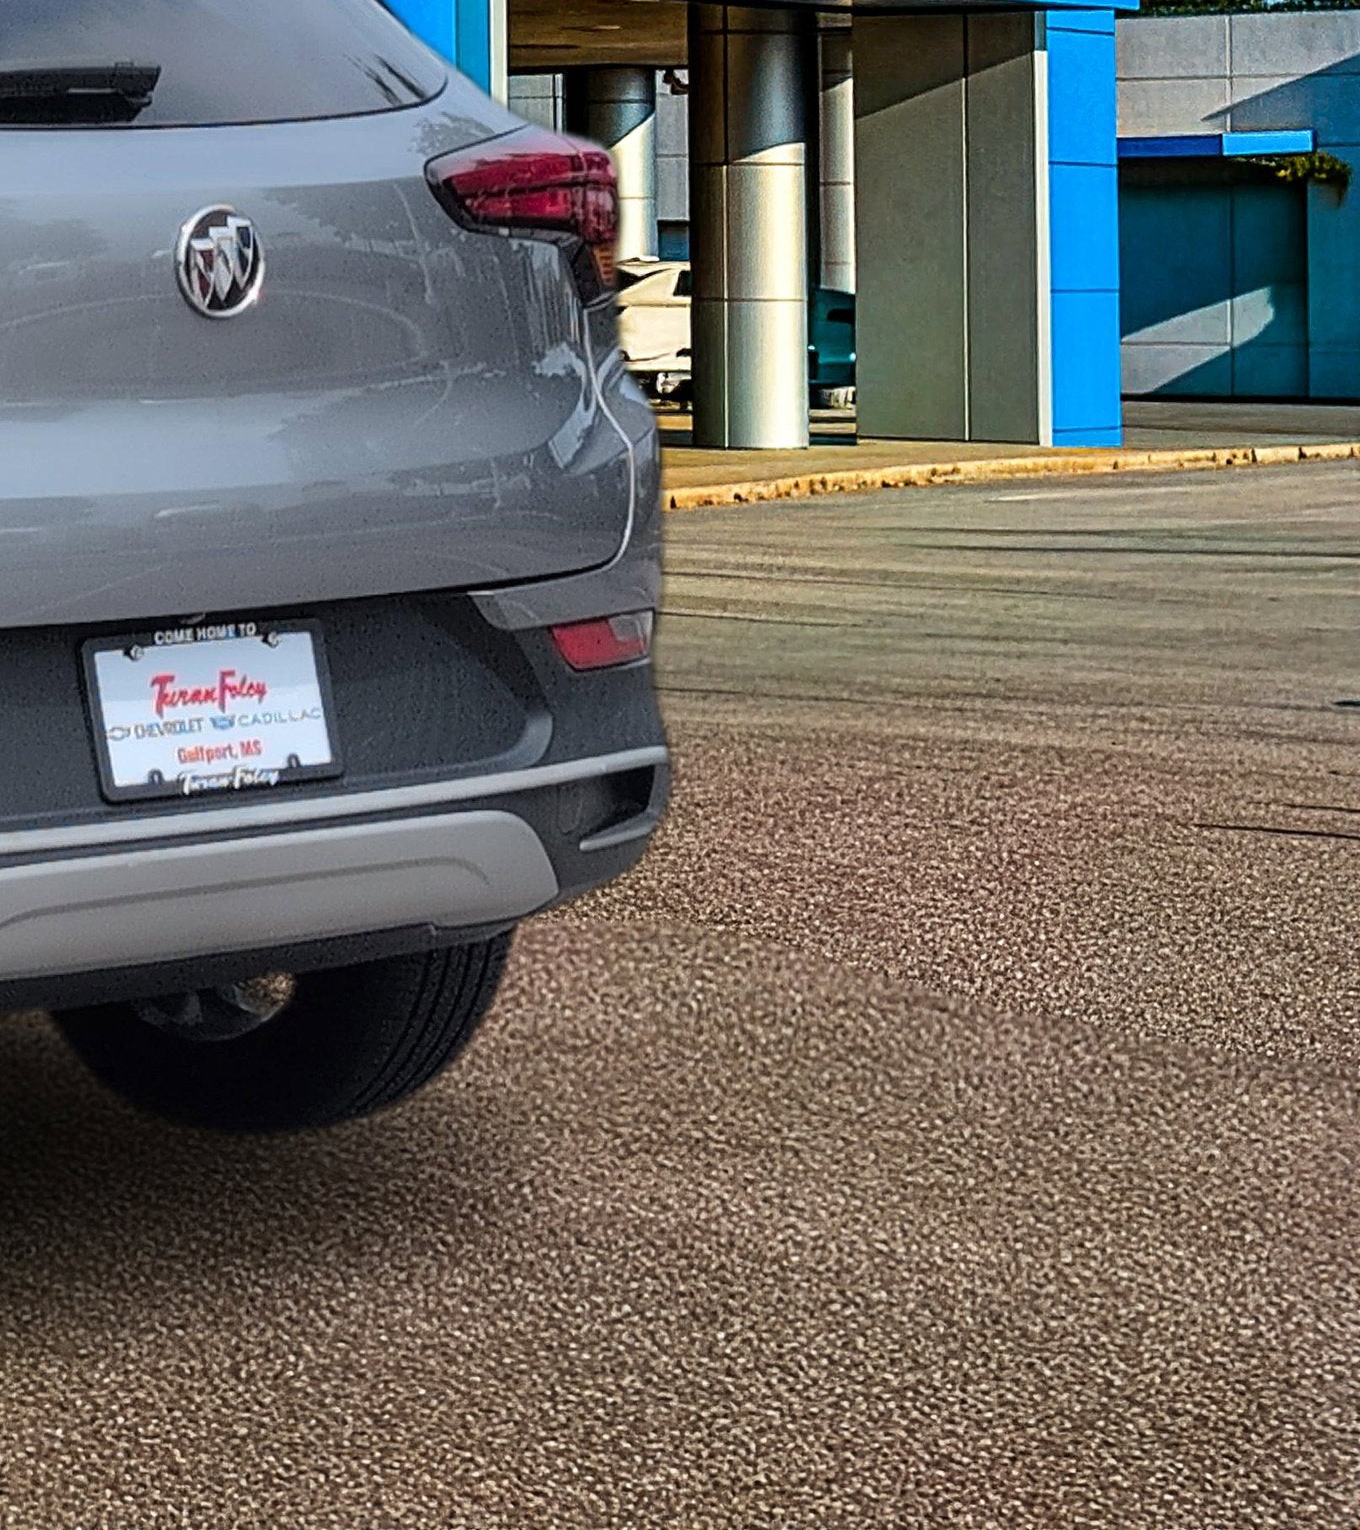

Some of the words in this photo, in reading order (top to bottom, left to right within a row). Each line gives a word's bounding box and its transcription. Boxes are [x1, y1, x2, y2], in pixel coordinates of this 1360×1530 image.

[154, 628, 194, 645] COME
[196, 623, 236, 641] HOME
[238, 621, 257, 637] TO
[237, 707, 322, 726] CADILLAC
[239, 739, 262, 757] MS
